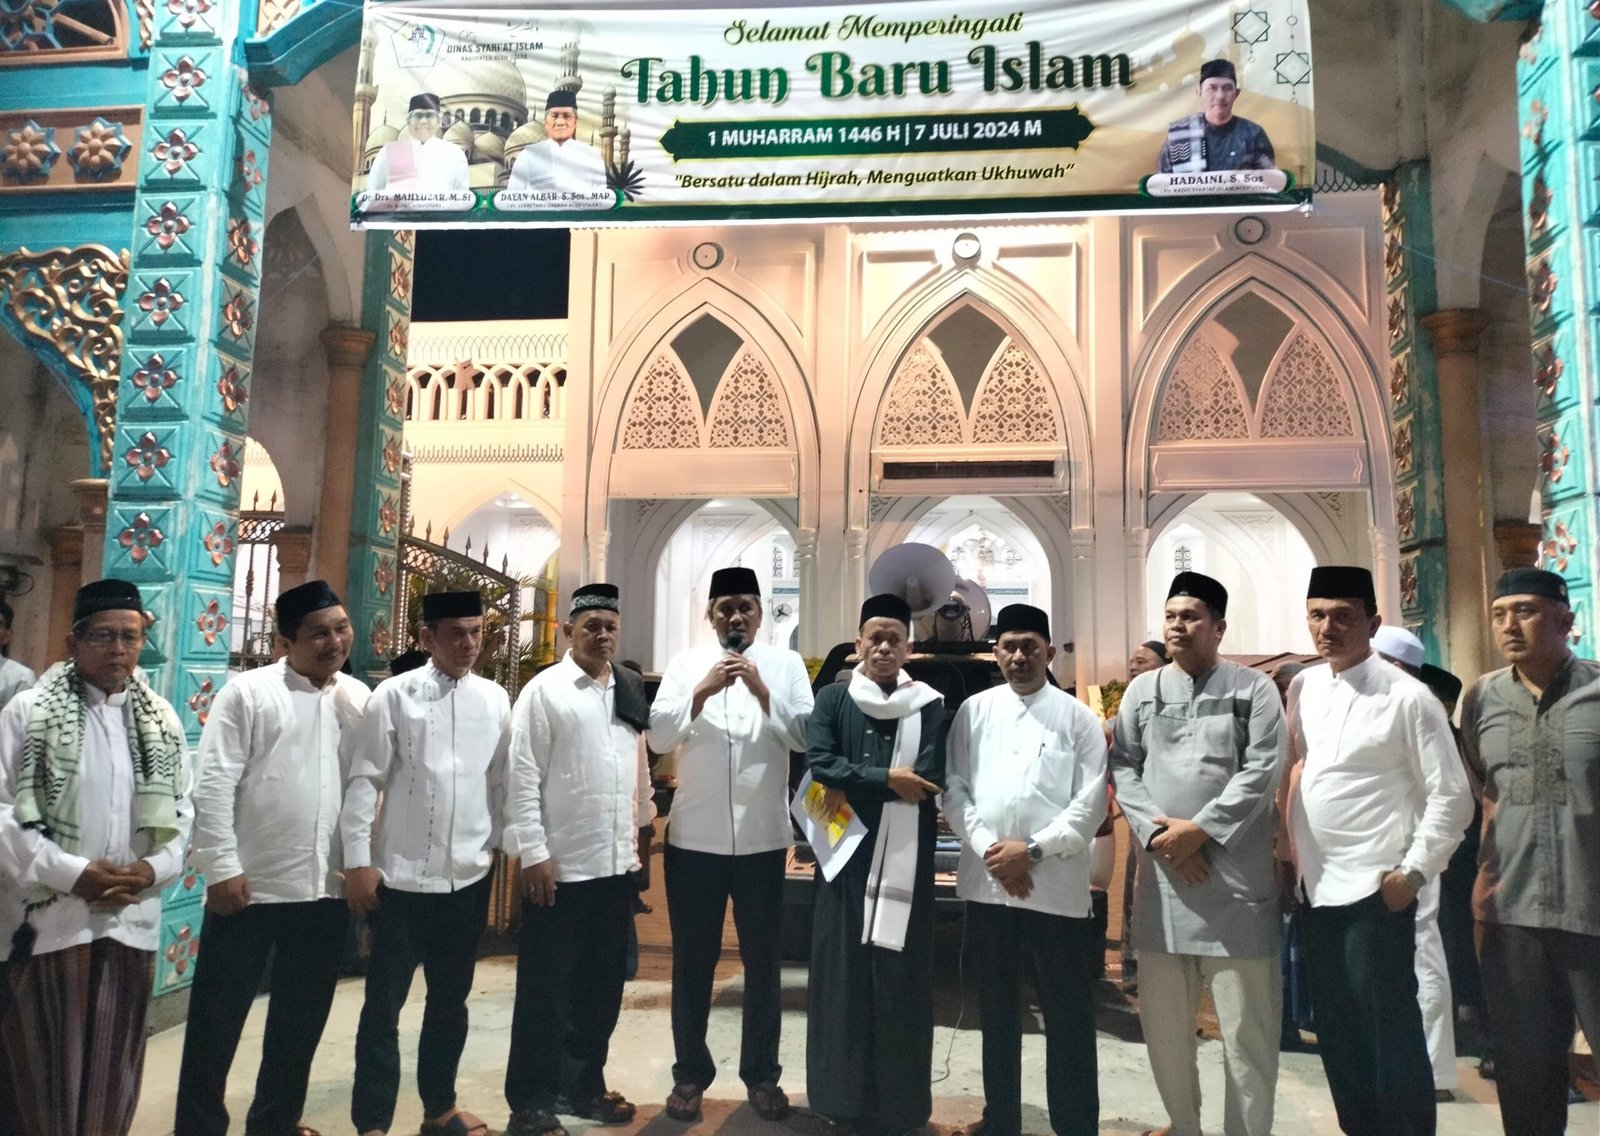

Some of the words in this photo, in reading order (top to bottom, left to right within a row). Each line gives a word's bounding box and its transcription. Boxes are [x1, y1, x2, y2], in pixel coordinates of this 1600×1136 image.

[724, 19, 831, 45] Selamat
[838, 12, 1024, 43] Memperingati
[447, 44, 473, 53] DINAS
[516, 42, 544, 51] ISLAM
[621, 54, 789, 108] Tahun
[805, 50, 953, 99] Baru
[967, 40, 1135, 93] Islam
[708, 130, 716, 146] 1
[722, 127, 833, 146] MUHARRAM
[838, 125, 883, 143] 1446
[886, 125, 900, 141] H
[914, 124, 927, 140] 7
[929, 122, 970, 141] JULI
[973, 121, 1020, 139] 2024
[1024, 119, 1042, 137] M
[748, 172, 801, 188] dalam
[806, 171, 862, 189] Hijrah,
[867, 167, 977, 187] Menguatkan
[501, 192, 528, 201] DAYAN
